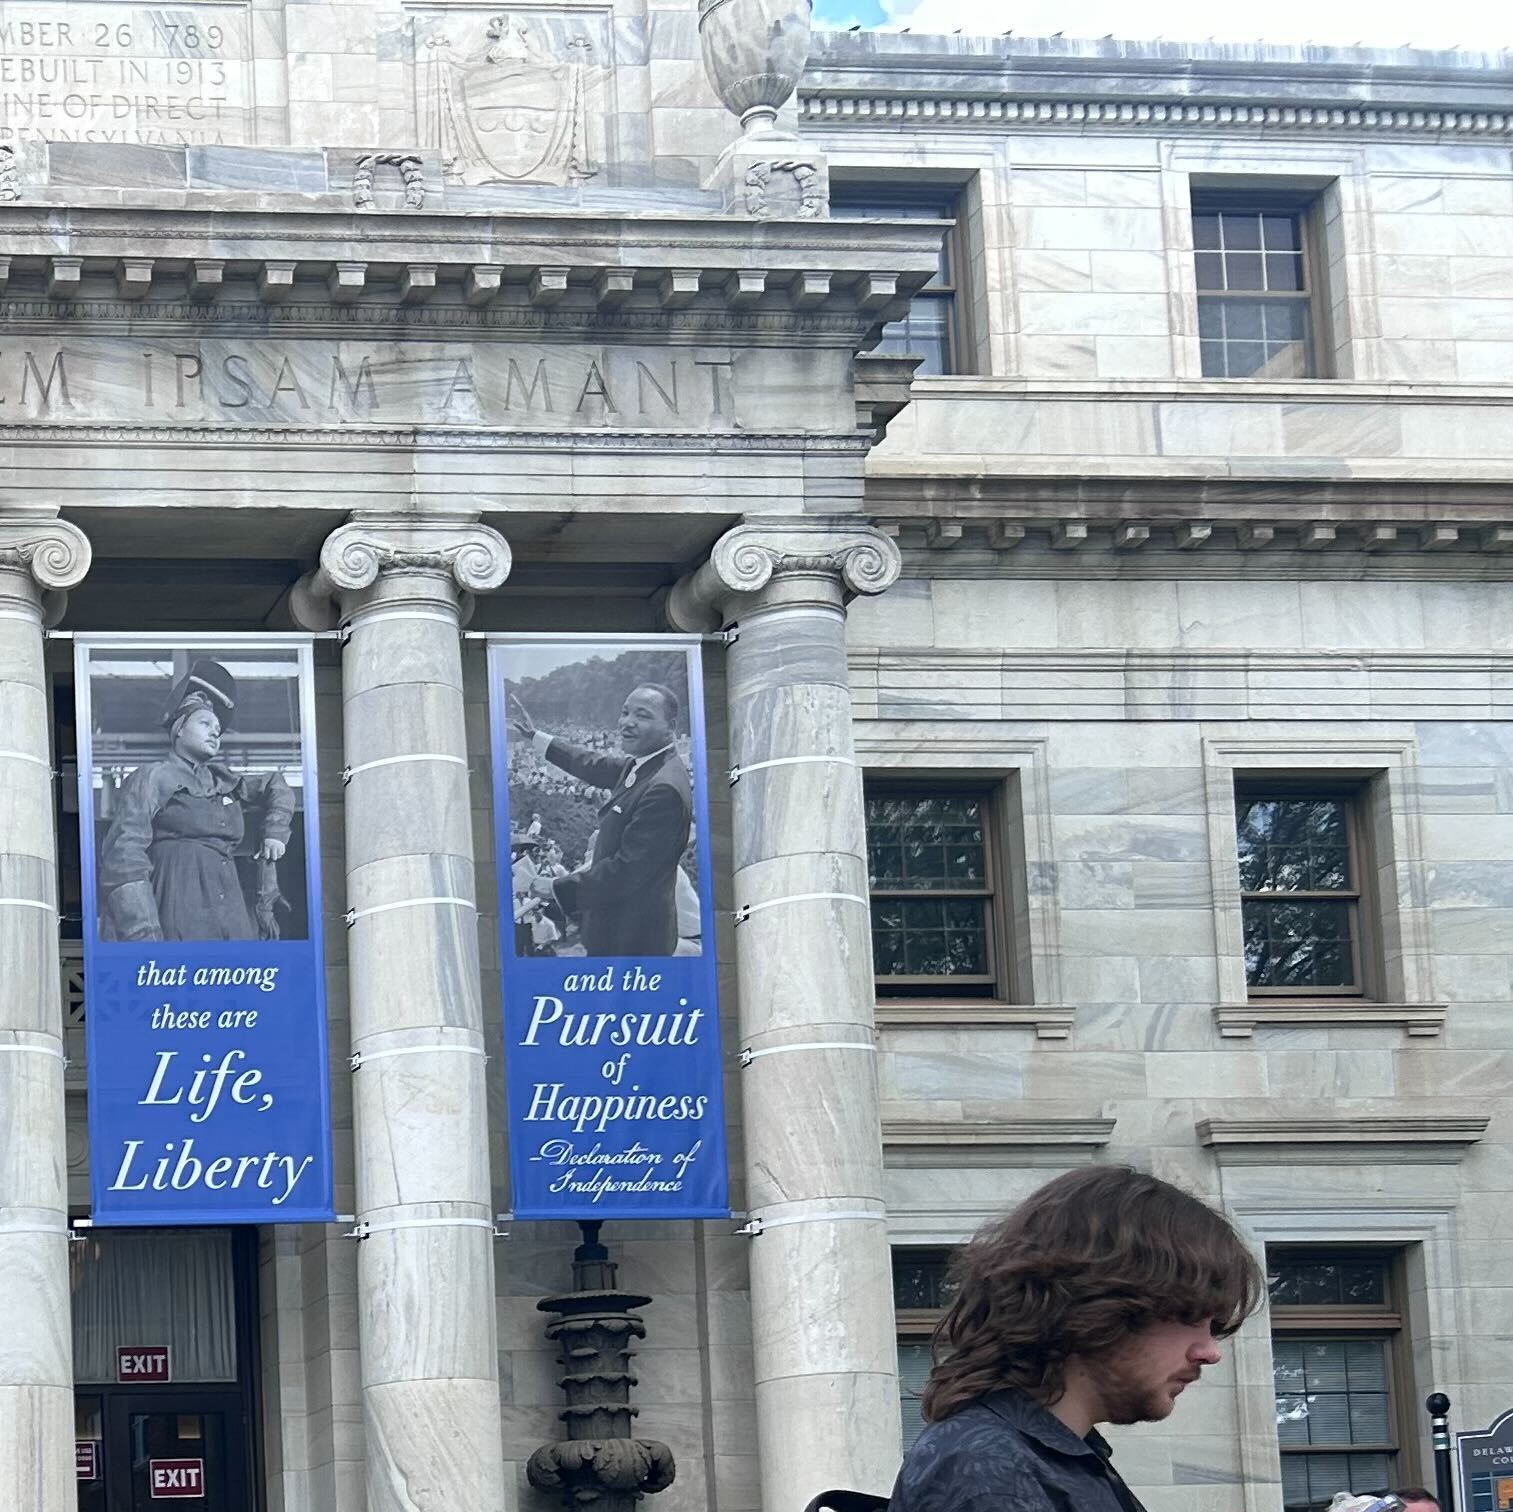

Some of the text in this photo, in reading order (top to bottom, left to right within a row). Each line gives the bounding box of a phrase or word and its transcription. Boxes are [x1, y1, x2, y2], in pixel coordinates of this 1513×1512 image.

[95, 23, 133, 48] 26
[152, 25, 224, 49] 1789
[120, 60, 149, 85] IN
[167, 61, 228, 87] 1913
[63, 94, 103, 119] OF
[113, 95, 227, 120] DIRECT
[143, 353, 380, 409] IPSAM
[445, 356, 737, 417] AMANT
[137, 960, 279, 992] that among
[564, 966, 662, 992] and the
[151, 1004, 258, 1030] these are
[519, 995, 704, 1047] Pursuit
[602, 1053, 631, 1085] of
[138, 1049, 275, 1123] Life,
[523, 1083, 708, 1133] Happiness
[107, 1138, 313, 1205] Liberty
[672, 1140, 703, 1179] of
[549, 1167, 684, 1203] Independence
[120, 1354, 166, 1374] EXIT
[153, 1468, 200, 1488] EXIT
